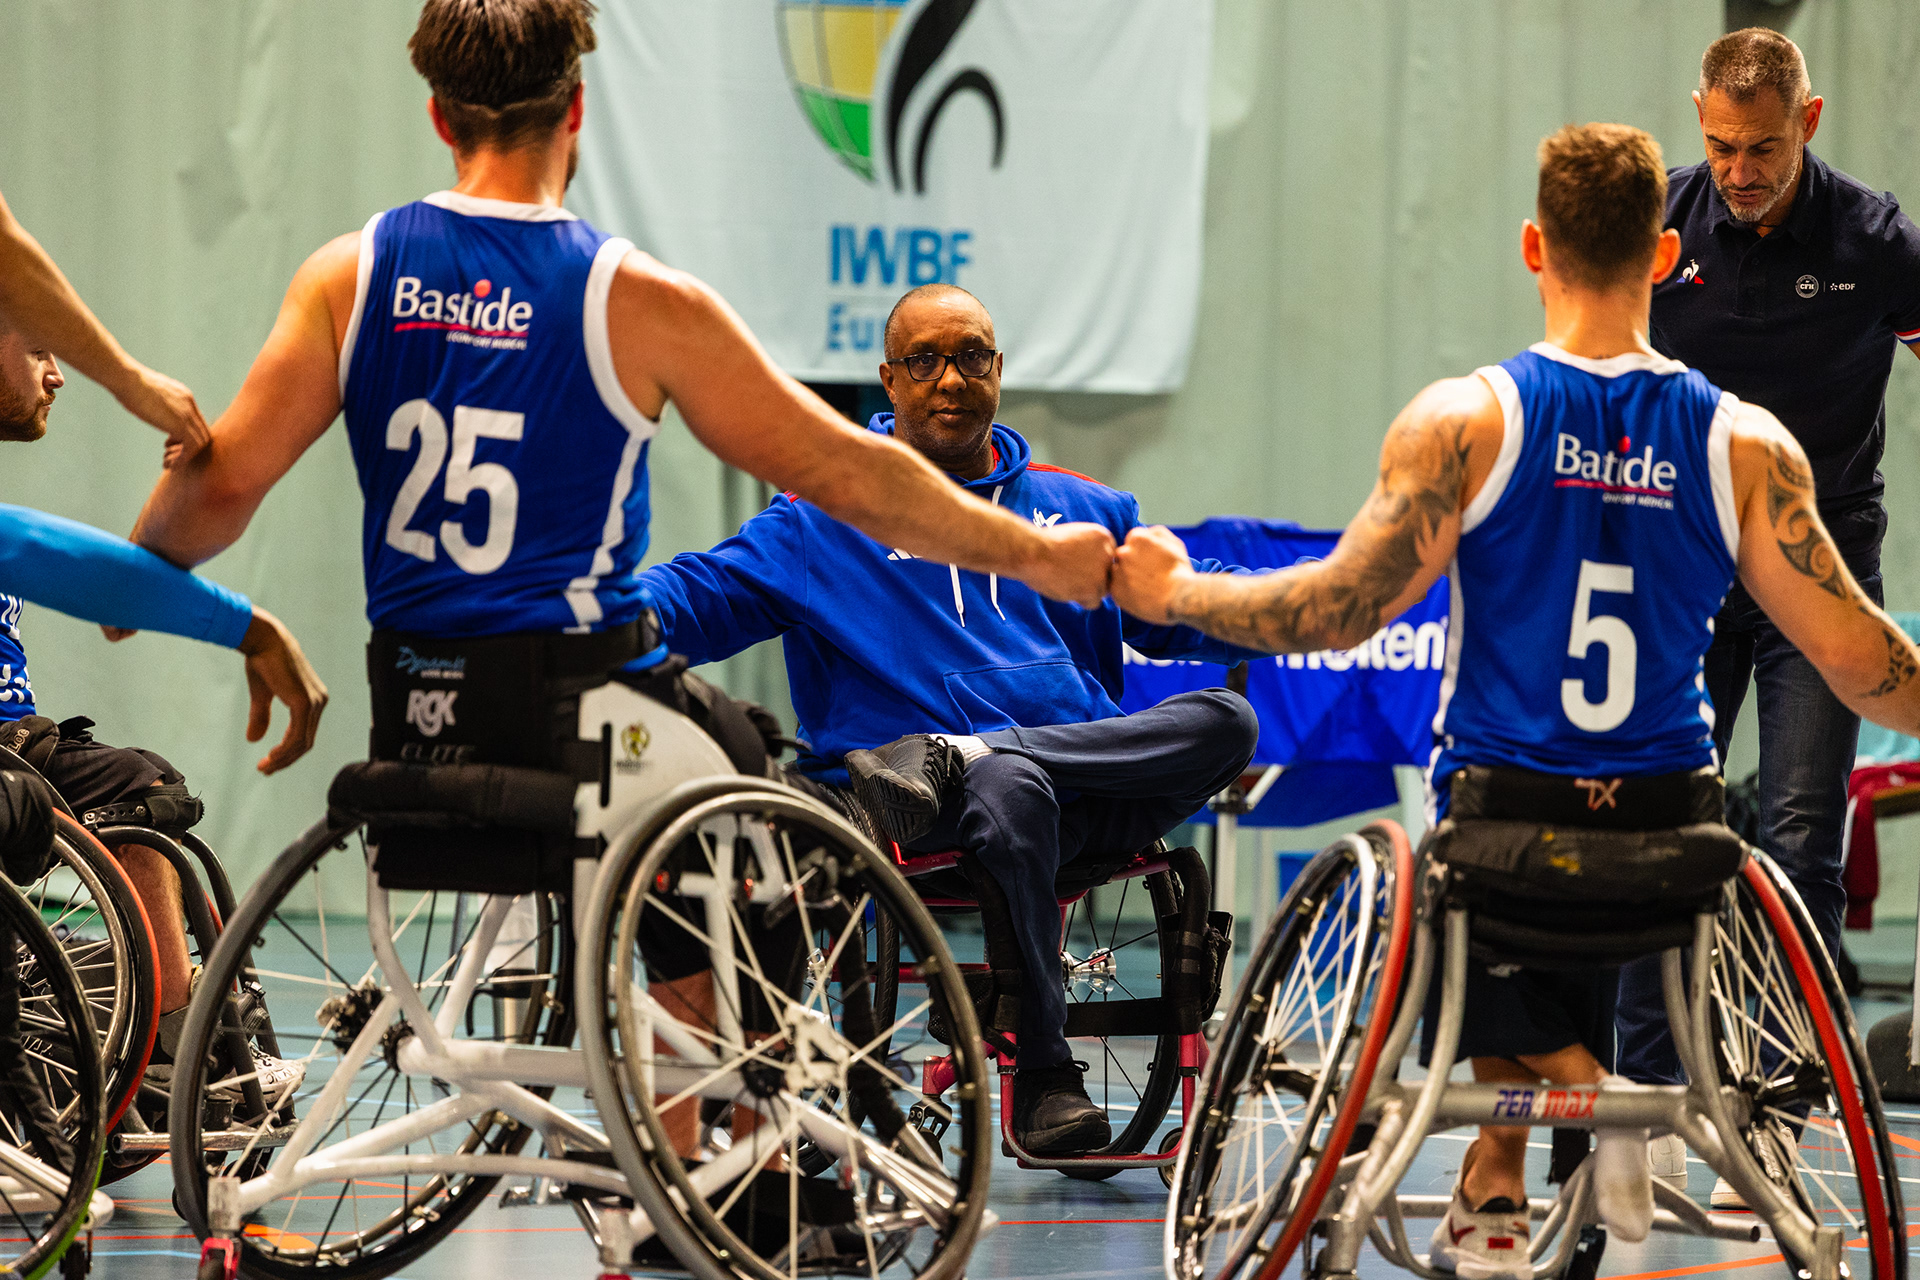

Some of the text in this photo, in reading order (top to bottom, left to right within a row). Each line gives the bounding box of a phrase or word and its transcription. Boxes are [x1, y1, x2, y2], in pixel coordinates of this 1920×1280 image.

[830, 225, 973, 286] IWBF
[393, 276, 533, 333] Bastide
[385, 398, 525, 576] 25
[1555, 432, 1677, 492] Batide
[1560, 558, 1637, 733] 5
[406, 689, 458, 737] RGK
